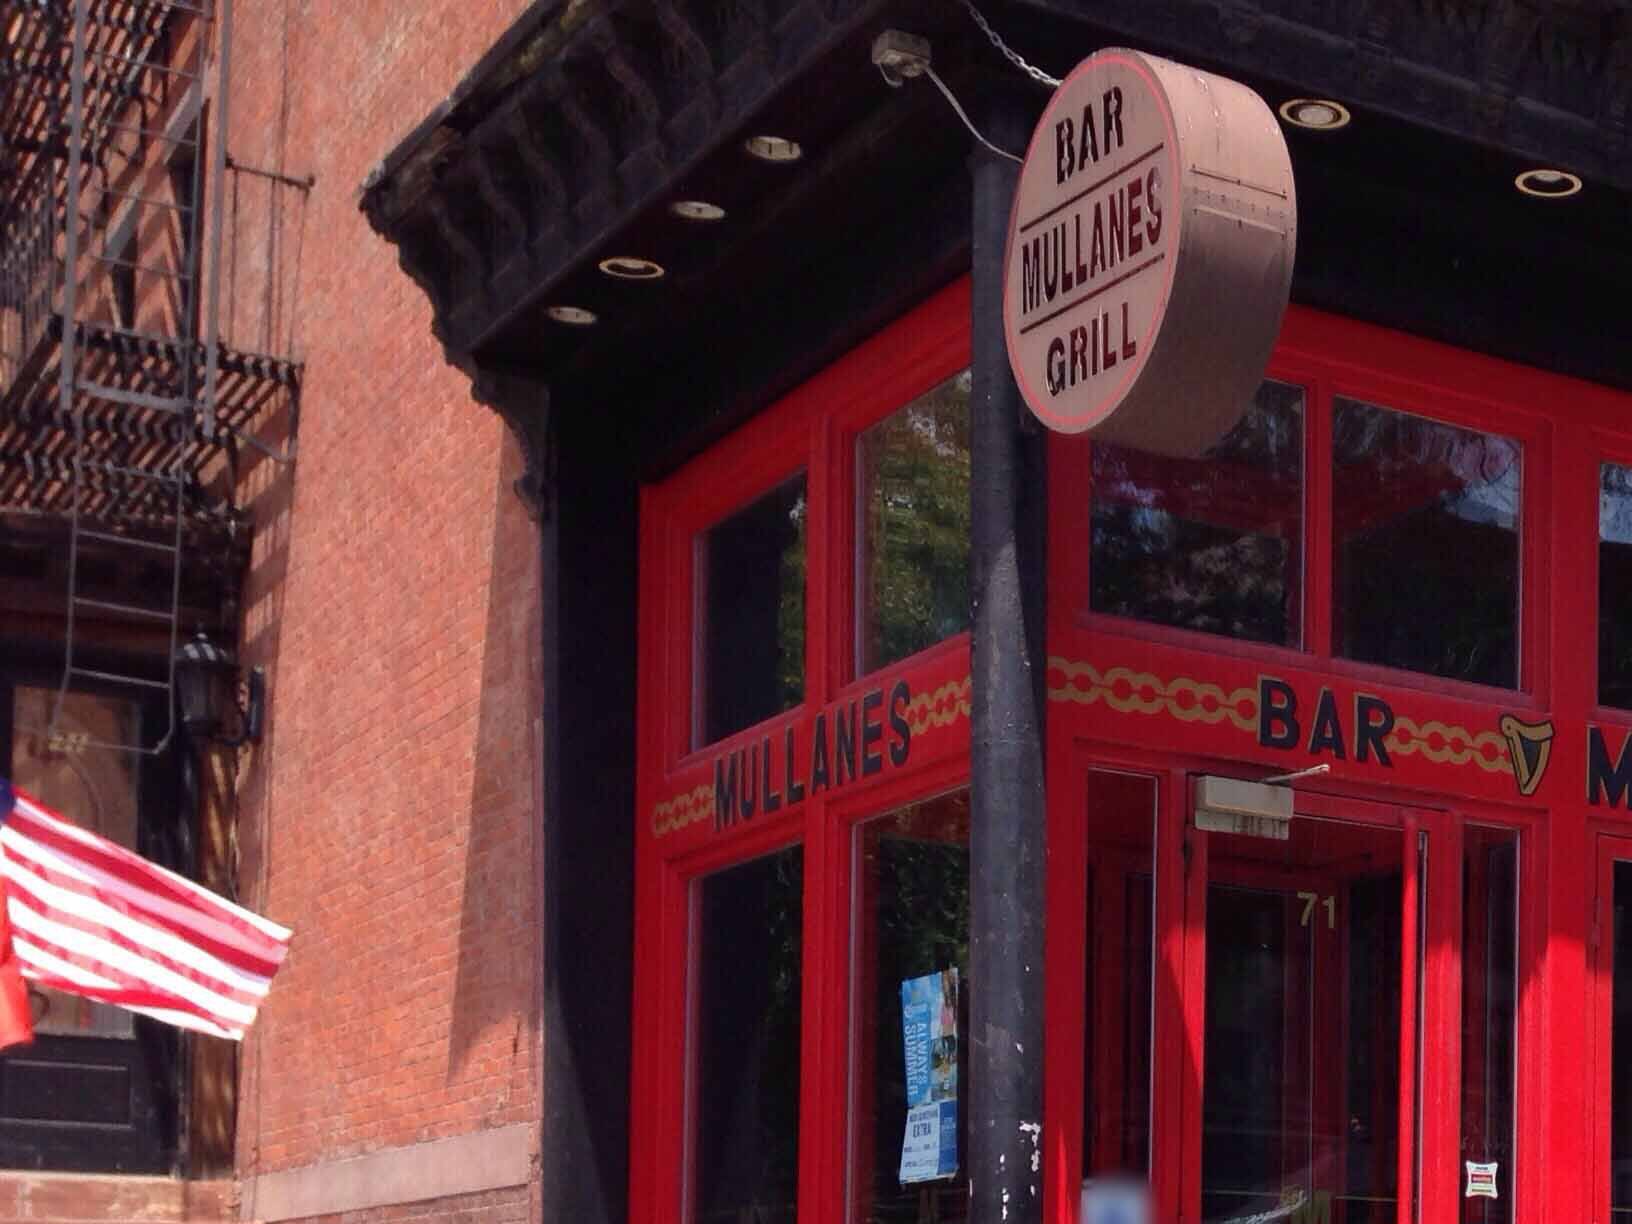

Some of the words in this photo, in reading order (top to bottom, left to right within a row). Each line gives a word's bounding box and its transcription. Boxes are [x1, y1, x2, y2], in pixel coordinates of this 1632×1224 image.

[1056, 86, 1124, 184] BAR
[1021, 167, 1162, 314] MULLANES
[1046, 302, 1137, 397] GRILL
[712, 679, 912, 833] MULLANES
[1256, 674, 1396, 768] BAR
[1297, 892, 1336, 929] 71
